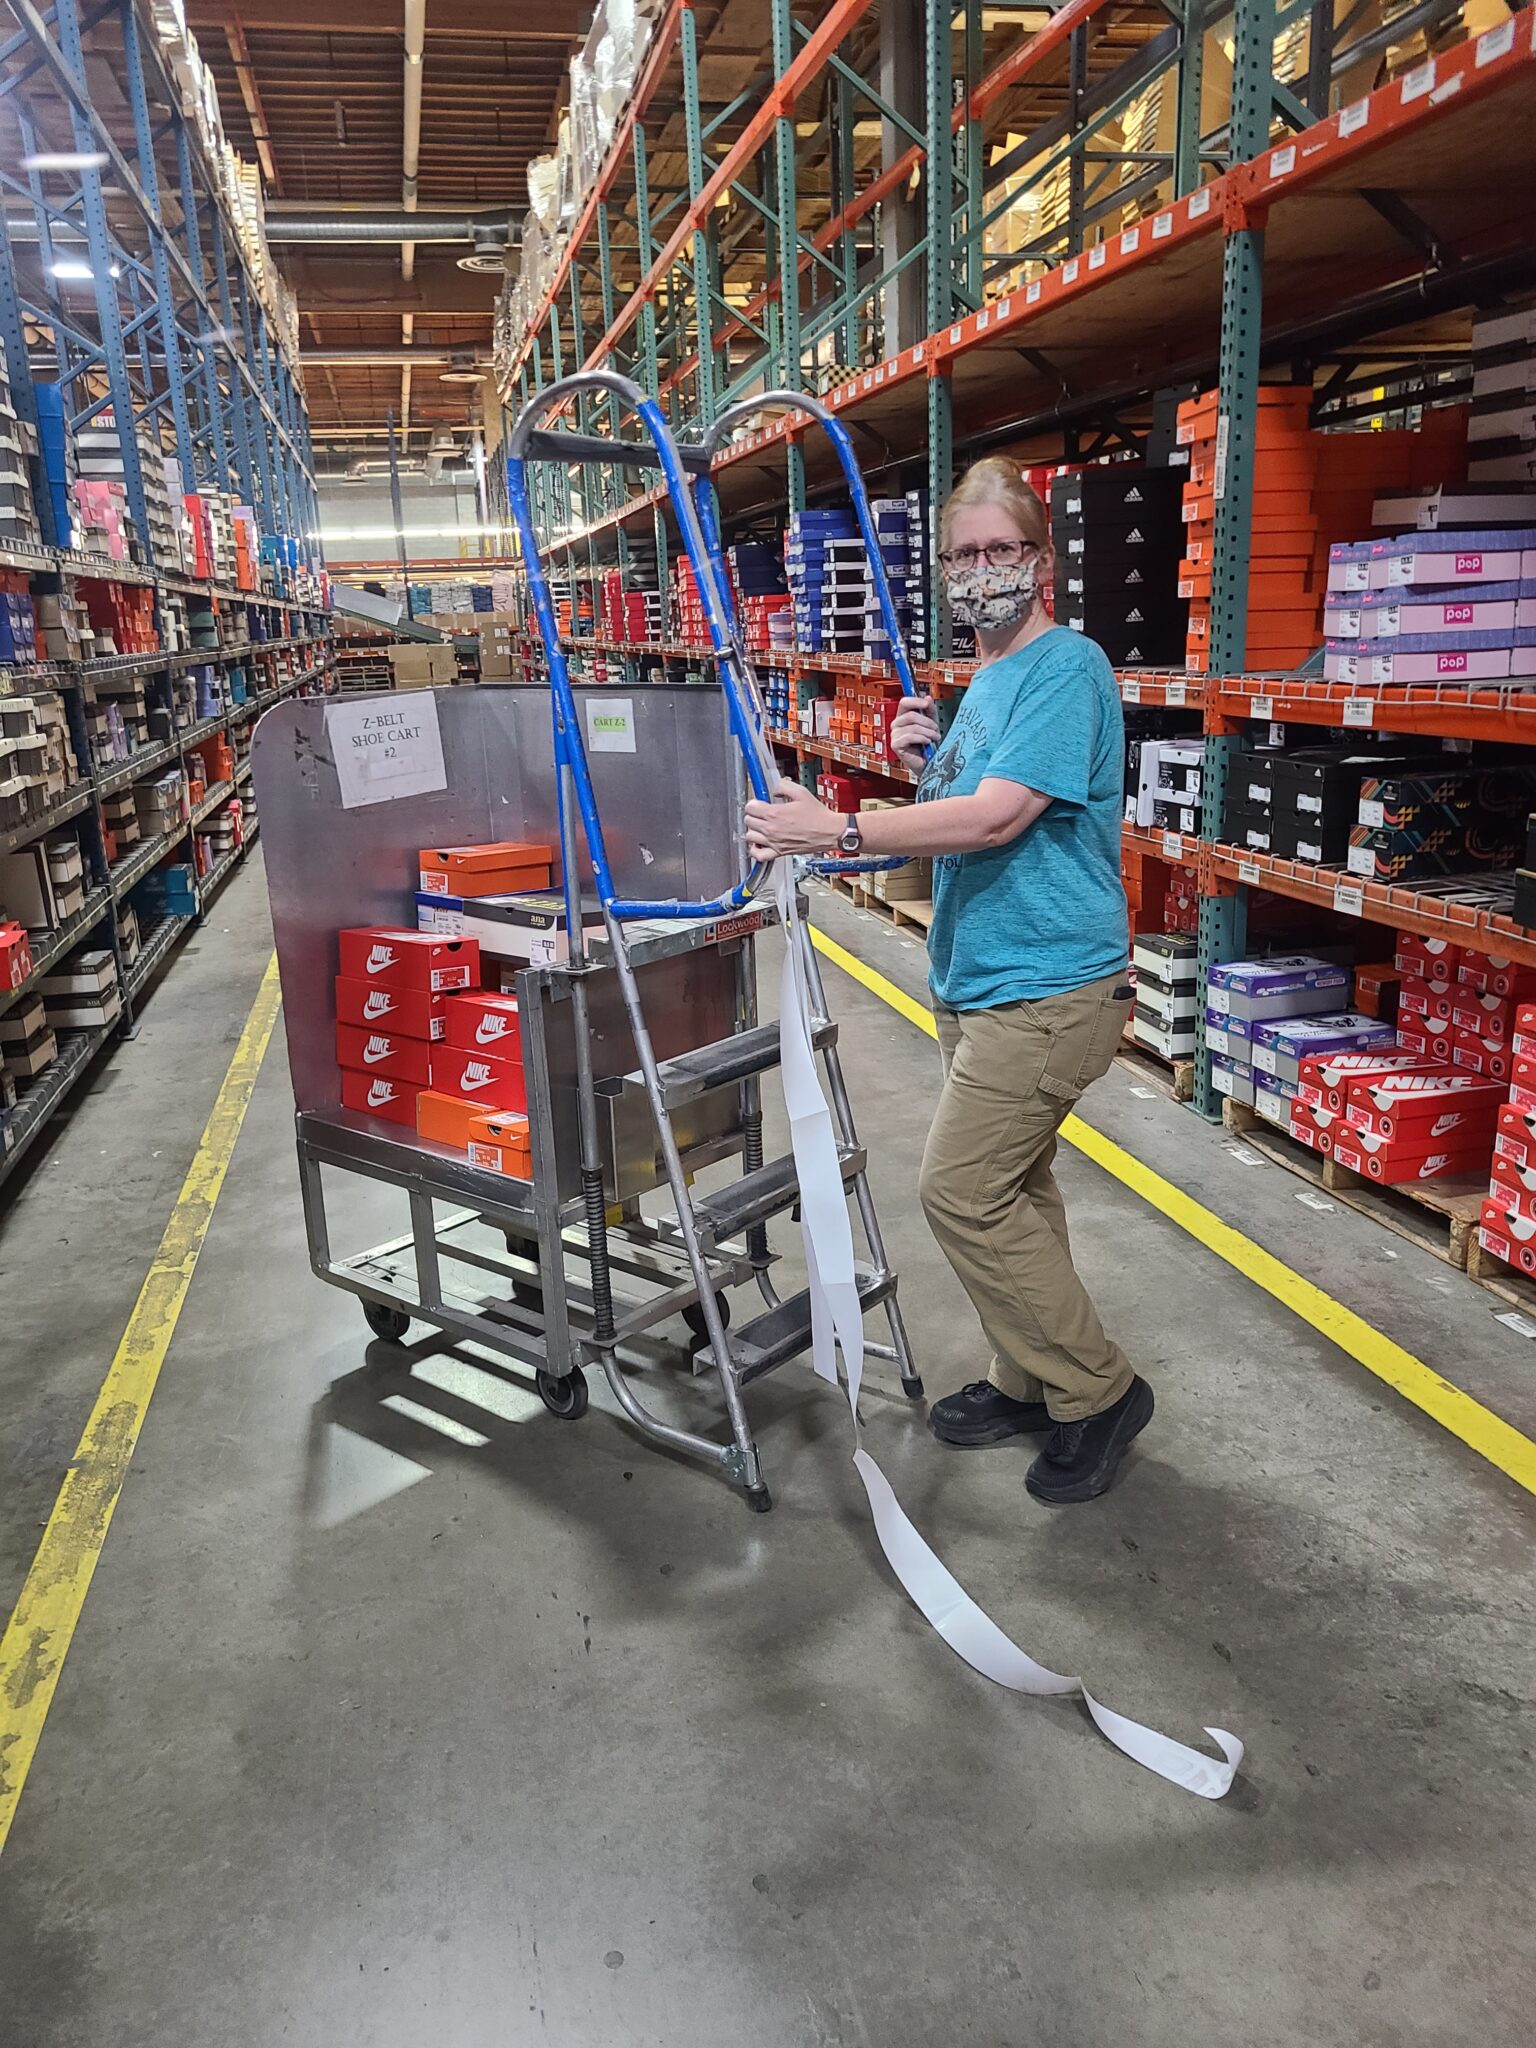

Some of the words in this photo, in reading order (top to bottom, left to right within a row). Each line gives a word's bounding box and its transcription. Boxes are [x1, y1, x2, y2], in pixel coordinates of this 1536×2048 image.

[1458, 558, 1480, 571] pop
[1446, 608, 1471, 621] pop
[1440, 656, 1465, 670] pop
[362, 713, 405, 729] Z-BELT
[593, 718, 613, 727] CART
[614, 718, 626, 727] Z-2
[352, 732, 385, 748] SHOE
[387, 727, 421, 742] CART
[384, 747, 397, 758] #2
[717, 914, 760, 935] Lockwood
[371, 944, 393, 964] NIKE
[368, 991, 391, 1010] NIKE
[482, 1013, 508, 1033] NIKE
[368, 1035, 391, 1054] NIKE
[1330, 1056, 1417, 1068] NIKE
[465, 1061, 491, 1081] NIKE
[371, 1079, 393, 1099] NIKE
[1382, 1076, 1472, 1090] NIKE
[1435, 1113, 1461, 1127] NIKE
[1424, 1154, 1448, 1168] NIKE
